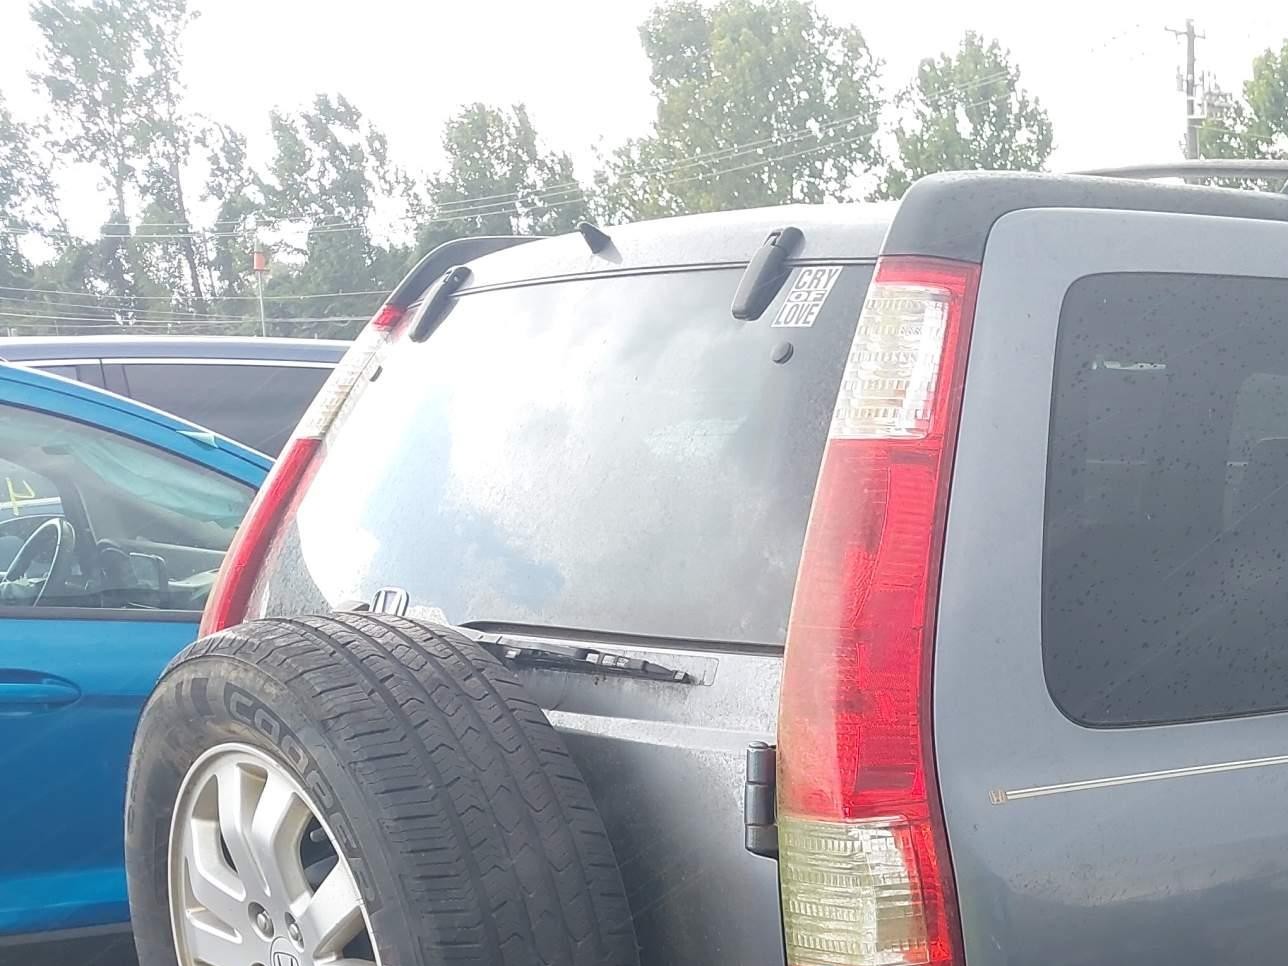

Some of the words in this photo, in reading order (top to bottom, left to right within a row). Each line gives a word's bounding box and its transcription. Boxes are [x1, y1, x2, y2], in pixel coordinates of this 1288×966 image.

[796, 268, 838, 290] CRY
[788, 291, 826, 302] OF
[774, 303, 819, 326] LOVE
[229, 692, 376, 902] COOPER
